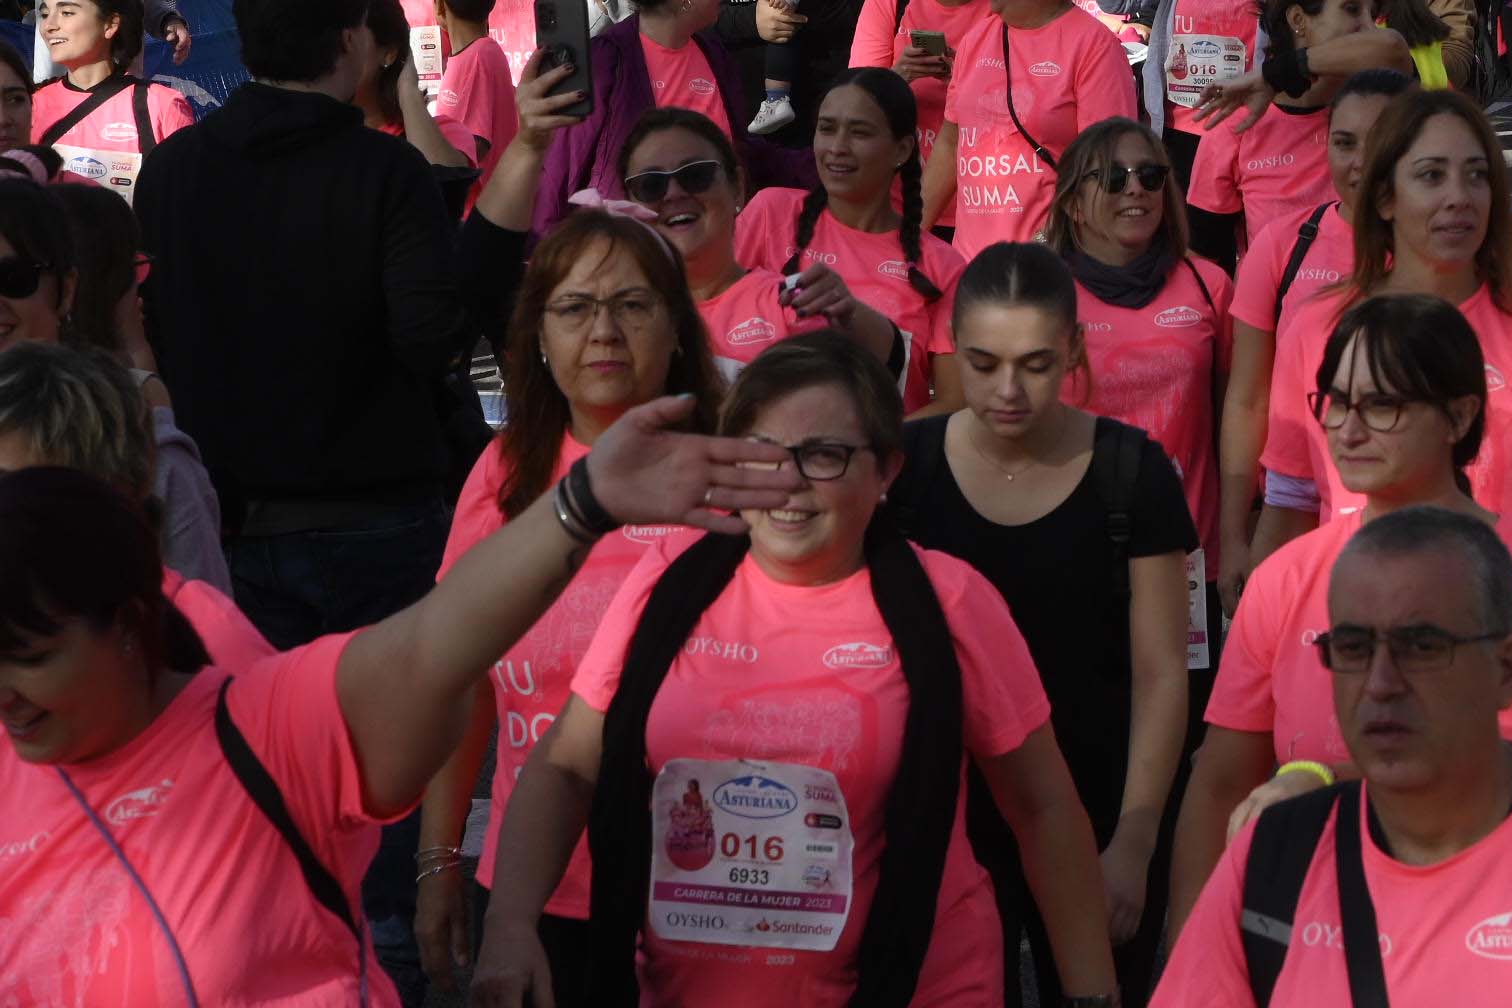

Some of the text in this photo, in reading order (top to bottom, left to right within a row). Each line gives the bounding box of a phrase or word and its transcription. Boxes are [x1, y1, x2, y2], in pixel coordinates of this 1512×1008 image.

[1174, 15, 1193, 34] TU
[1190, 64, 1217, 75] 016
[960, 153, 1044, 176] DORSAL
[1247, 153, 1295, 171] OYSHO
[963, 184, 1020, 206] SUMA
[685, 638, 759, 663] OYSHO
[721, 791, 791, 810] ASTURIANA
[720, 833, 785, 861] 016
[729, 867, 770, 886] 6933
[673, 888, 832, 909] CARRERA DE LA MUJER 2023
[667, 911, 834, 937] OYSHO Santander
